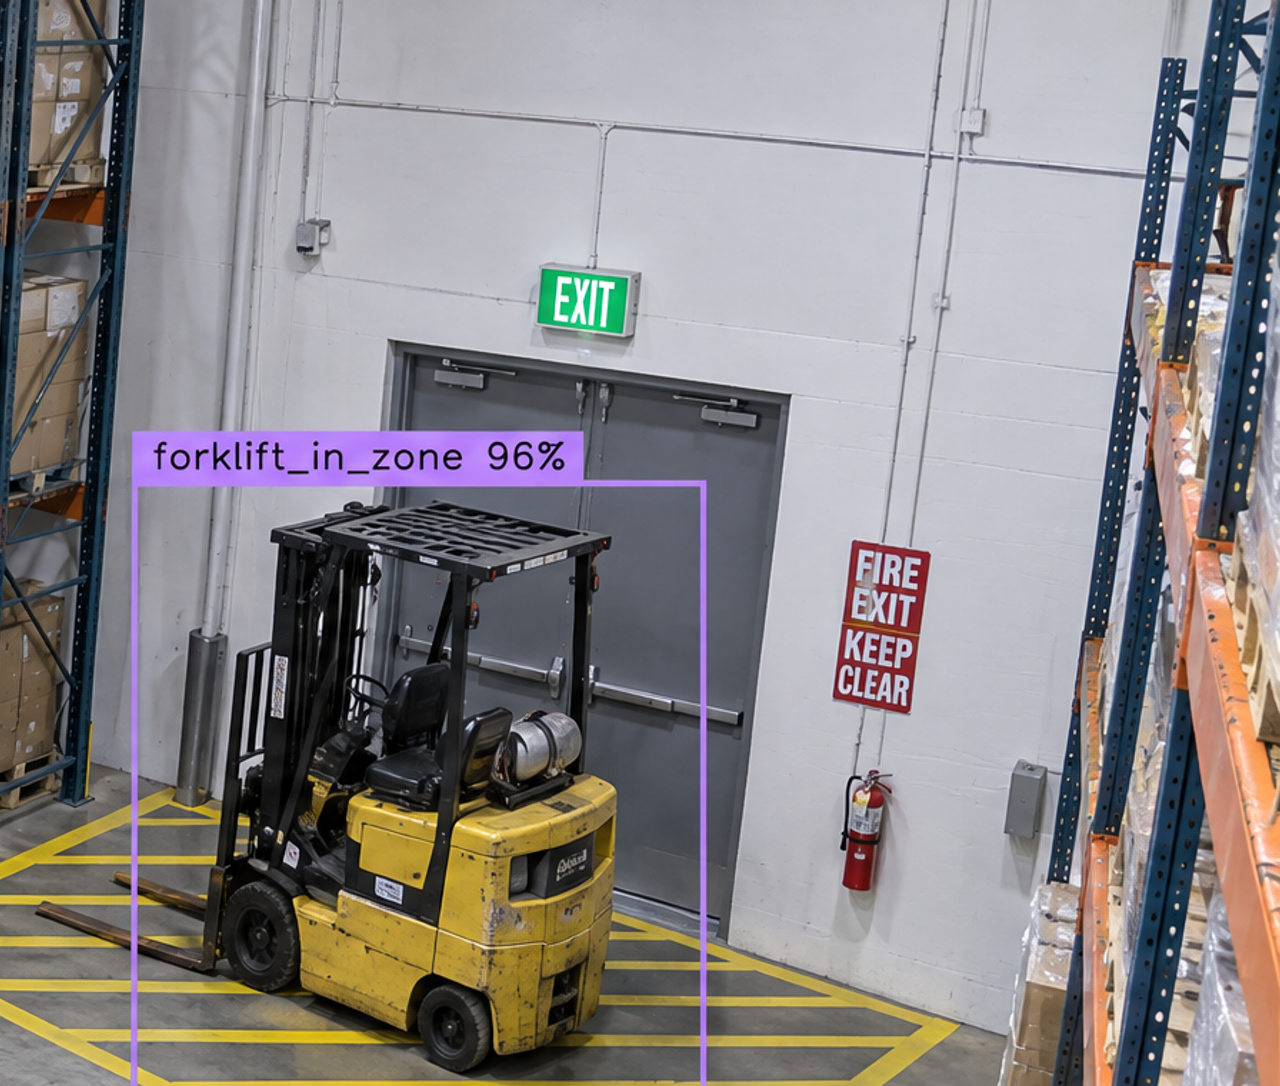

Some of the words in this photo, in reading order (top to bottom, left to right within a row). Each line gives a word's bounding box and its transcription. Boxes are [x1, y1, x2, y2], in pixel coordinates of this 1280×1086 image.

[553, 275, 616, 328] EXIT
[855, 548, 922, 591] FIRE
[851, 586, 917, 628] EXIT
[843, 628, 913, 669] KEEP
[837, 663, 910, 707] CLEAR
